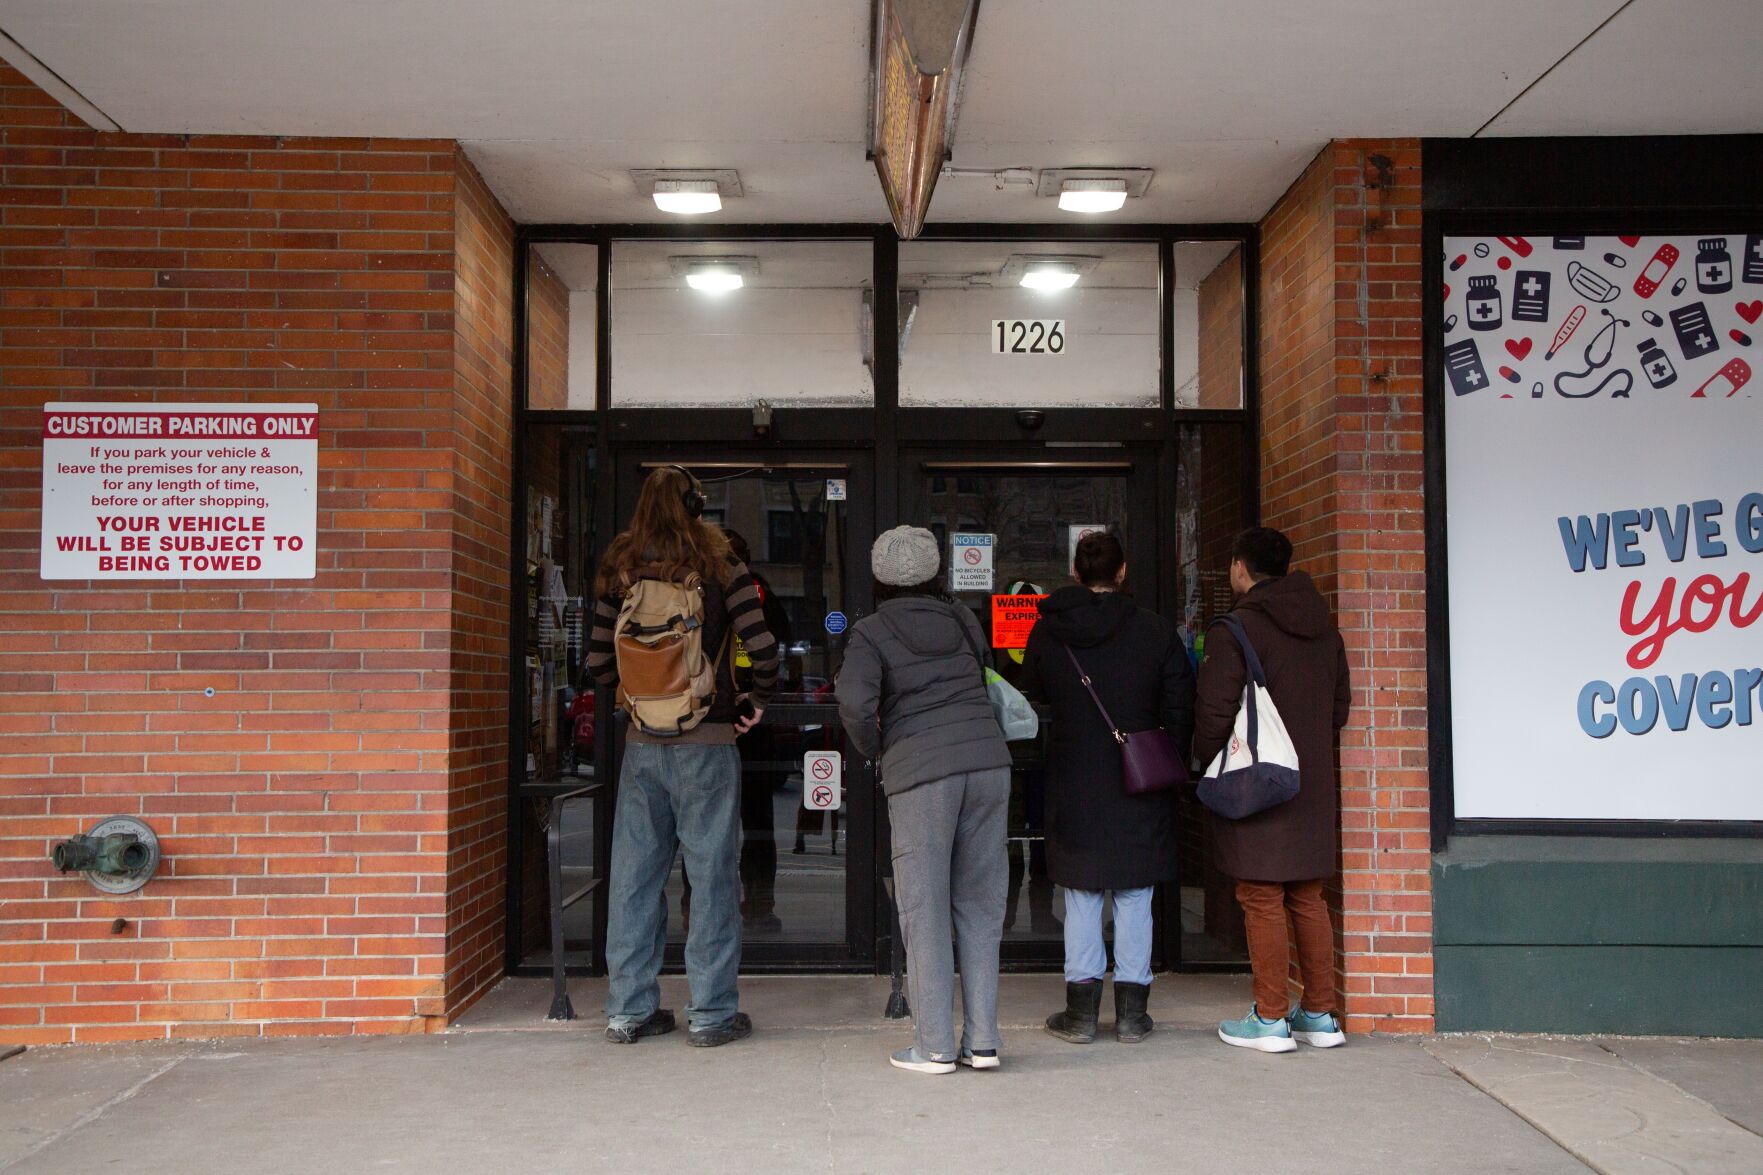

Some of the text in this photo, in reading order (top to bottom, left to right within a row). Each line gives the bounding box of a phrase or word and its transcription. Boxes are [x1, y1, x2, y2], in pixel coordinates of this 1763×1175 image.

[997, 321, 1064, 353] 1226
[48, 416, 315, 435] CUSTOMER PARKING ONLY
[90, 447, 271, 459] If you park your vehicle &
[57, 463, 303, 477] leave the premises for any reason,
[103, 478, 259, 493] for any length of time,
[91, 494, 269, 509] before or after shopping,
[97, 516, 265, 533] YOUR VEHICLE
[1557, 491, 1763, 573] WE'VE G
[56, 535, 304, 552] WILL BE SUBJECT TO
[955, 536, 991, 545] NOTICE
[98, 555, 263, 572] BEING TOWED
[996, 597, 1043, 607] WARNI
[1005, 612, 1043, 621] EXPIRE
[1576, 667, 1763, 740] cover
